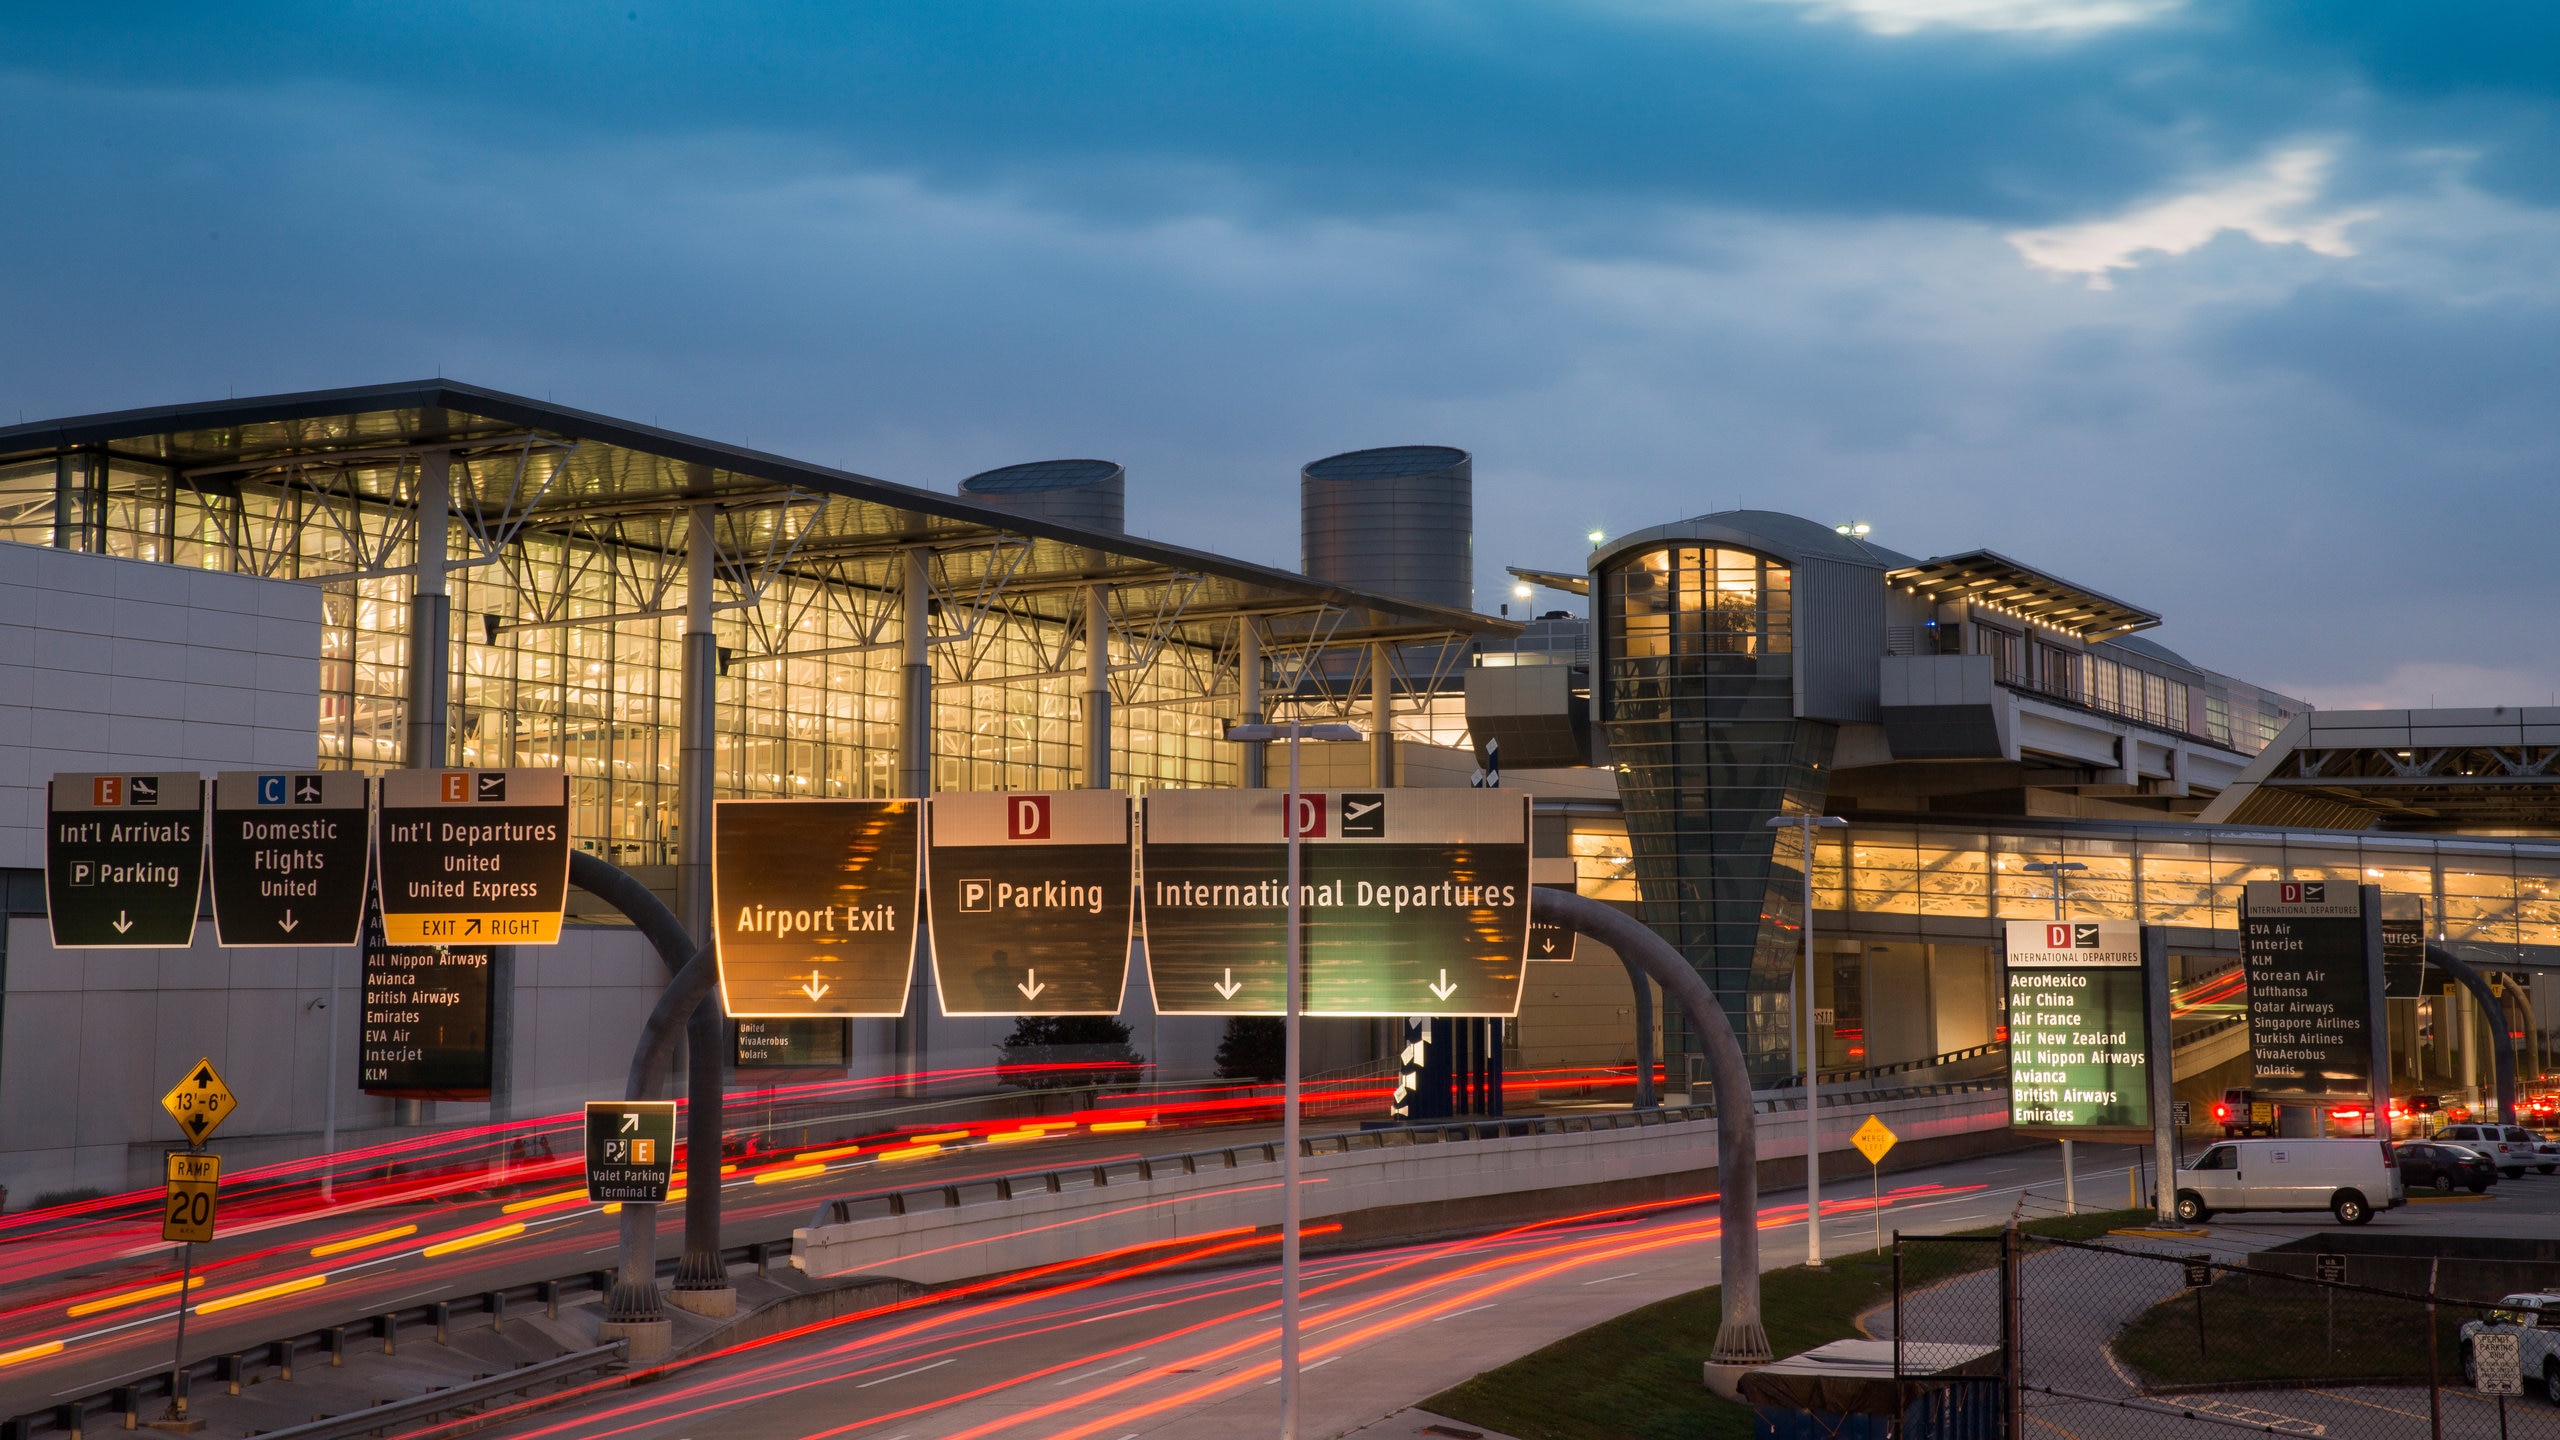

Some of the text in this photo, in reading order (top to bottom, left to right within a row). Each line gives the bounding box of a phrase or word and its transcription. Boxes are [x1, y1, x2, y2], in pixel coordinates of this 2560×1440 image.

[102, 780, 114, 803] E
[264, 778, 280, 802] C
[449, 776, 461, 799] E
[1018, 800, 1040, 836] D
[60, 821, 191, 843] Int'l Arrivals
[242, 818, 338, 840] Domestic
[390, 821, 557, 847] Int'l Departures
[254, 849, 324, 875] Flights
[444, 854, 501, 872] United
[75, 862, 180, 888] P Parking
[261, 879, 317, 897] United
[408, 880, 538, 901] United Express
[2285, 885, 2296, 901] D
[966, 879, 1103, 914] P Parking
[1357, 880, 1516, 914] Departures
[2249, 906, 2358, 915] INTERNATIONAL DEPARTURES
[422, 919, 540, 936] EXIT RIGHT
[737, 903, 896, 939] Airport Exit
[2052, 926, 2065, 946] D
[2250, 923, 2291, 935] EVA Air
[2251, 937, 2304, 951] Interjet
[2383, 932, 2418, 944] tures
[368, 953, 488, 969] All Nippon Airways
[2010, 952, 2138, 962] INTERNATIONAL DEPARTURES
[2252, 955, 2273, 966] KLM
[367, 972, 416, 985] Avianca
[2011, 973, 2087, 988] AeroMexico
[2252, 970, 2326, 981] Korean Air
[367, 990, 460, 1007] British Airways
[2253, 986, 2308, 997] Lufthansa
[2012, 992, 2075, 1007] Air China
[2254, 1001, 2334, 1015] Qatar Airways
[366, 1010, 420, 1023] Emirates
[2012, 1011, 2082, 1026] Air France
[2255, 1017, 2361, 1031] Singapore Airlines
[365, 1029, 411, 1042] EVA Air
[740, 1023, 766, 1033] United
[739, 1036, 789, 1046] VivaAerobus
[2012, 1030, 2127, 1045] Air New Zealand
[2255, 1033, 2344, 1045] Turkish Airlines
[366, 1046, 423, 1062] Interjet
[739, 1049, 768, 1060] Volaris
[2013, 1050, 2146, 1067] All Nippon Airways
[2255, 1048, 2326, 1060] VivaAerobus
[365, 1068, 388, 1081] KLM
[2014, 1069, 2067, 1083] Avianca
[2256, 1064, 2296, 1075] Volaris
[2014, 1088, 2118, 1106] British Airways
[2015, 1107, 2074, 1122] Emirates
[606, 1142, 648, 1162] P E
[177, 1161, 211, 1177] RAMP
[592, 1169, 666, 1184] Valet Parking
[600, 1186, 657, 1198] Terminal E
[170, 1191, 210, 1226] 20
[2481, 1335, 2509, 1344] PERMIT
[2479, 1344, 2514, 1352] PARKING
